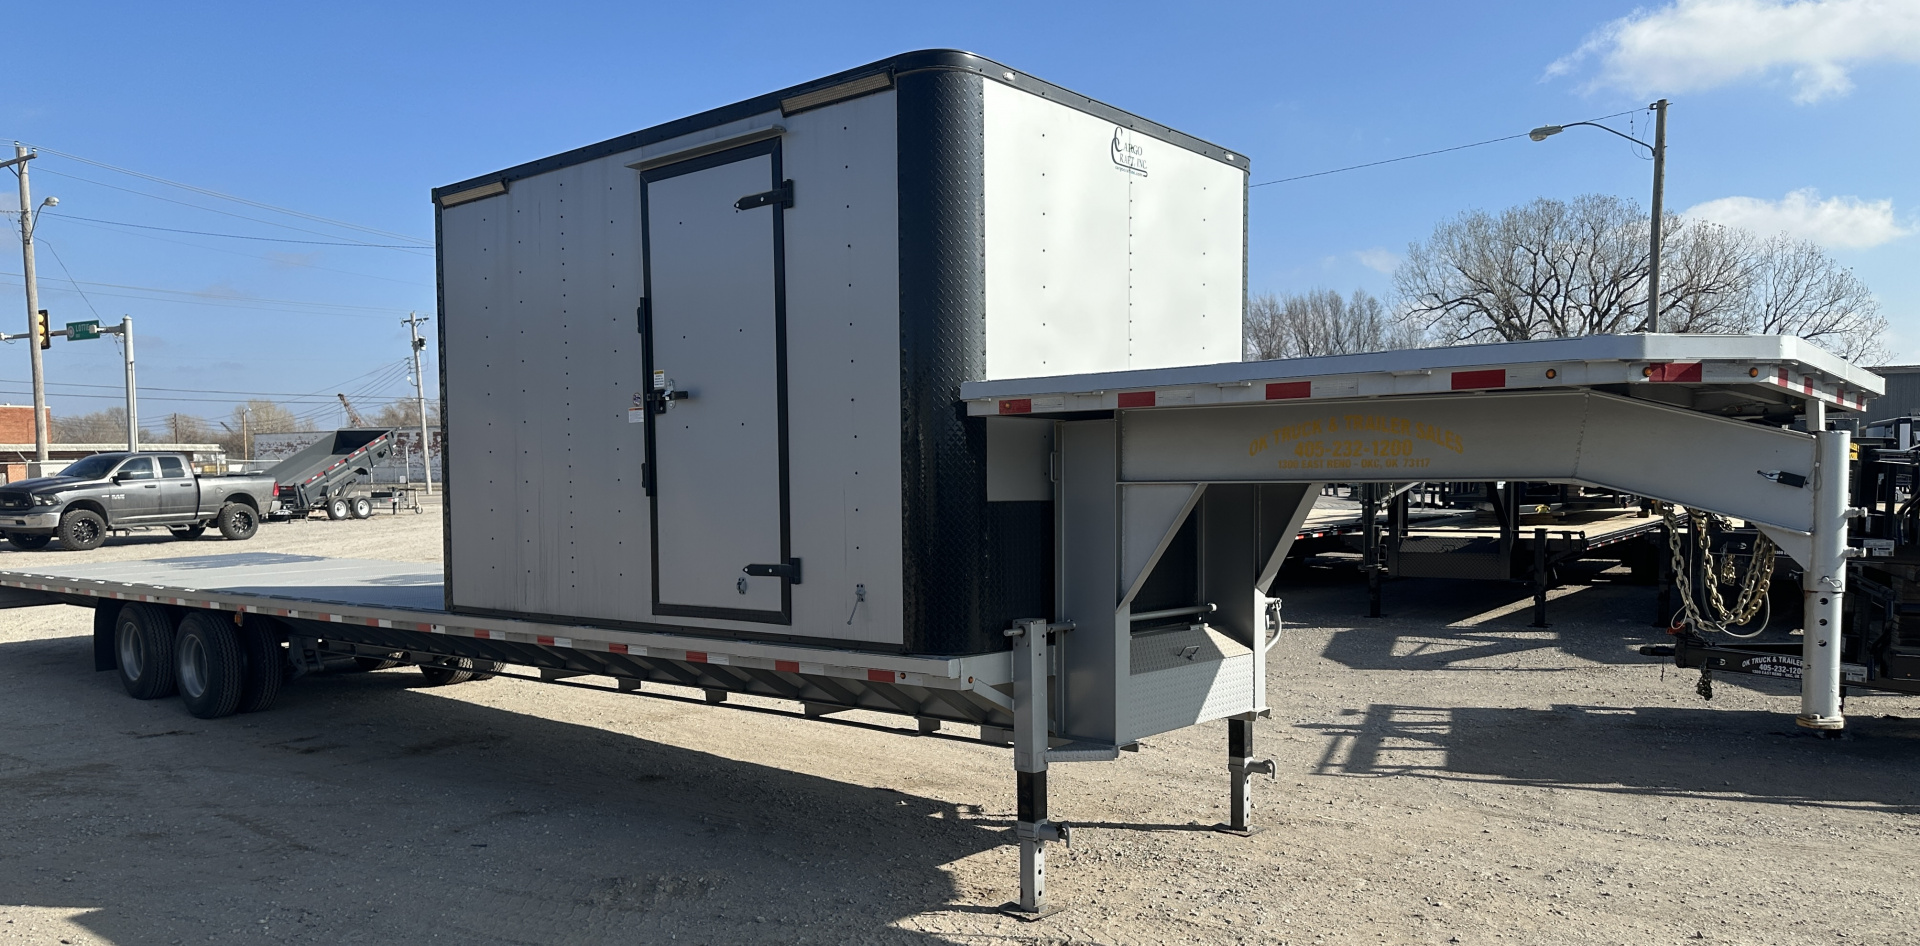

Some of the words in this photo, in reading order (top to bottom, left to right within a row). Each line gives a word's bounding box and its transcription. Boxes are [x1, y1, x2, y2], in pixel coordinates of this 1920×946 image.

[1249, 433, 1269, 457] OK
[1272, 418, 1323, 446] TRUCK
[1328, 416, 1339, 433] &
[1344, 414, 1412, 436] TRAILER
[1416, 421, 1464, 455] SALES
[1294, 438, 1413, 458] 405-232-1200
[1301, 459, 1323, 469] EAST
[1327, 459, 1351, 468] RENO
[1361, 458, 1383, 470] OKC,
[1385, 458, 1399, 468] OK
[1403, 457, 1431, 468] 73117
[1741, 659, 1751, 668] OK
[1752, 656, 1771, 665] TRUCK
[1759, 664, 1803, 674] 405-232-120
